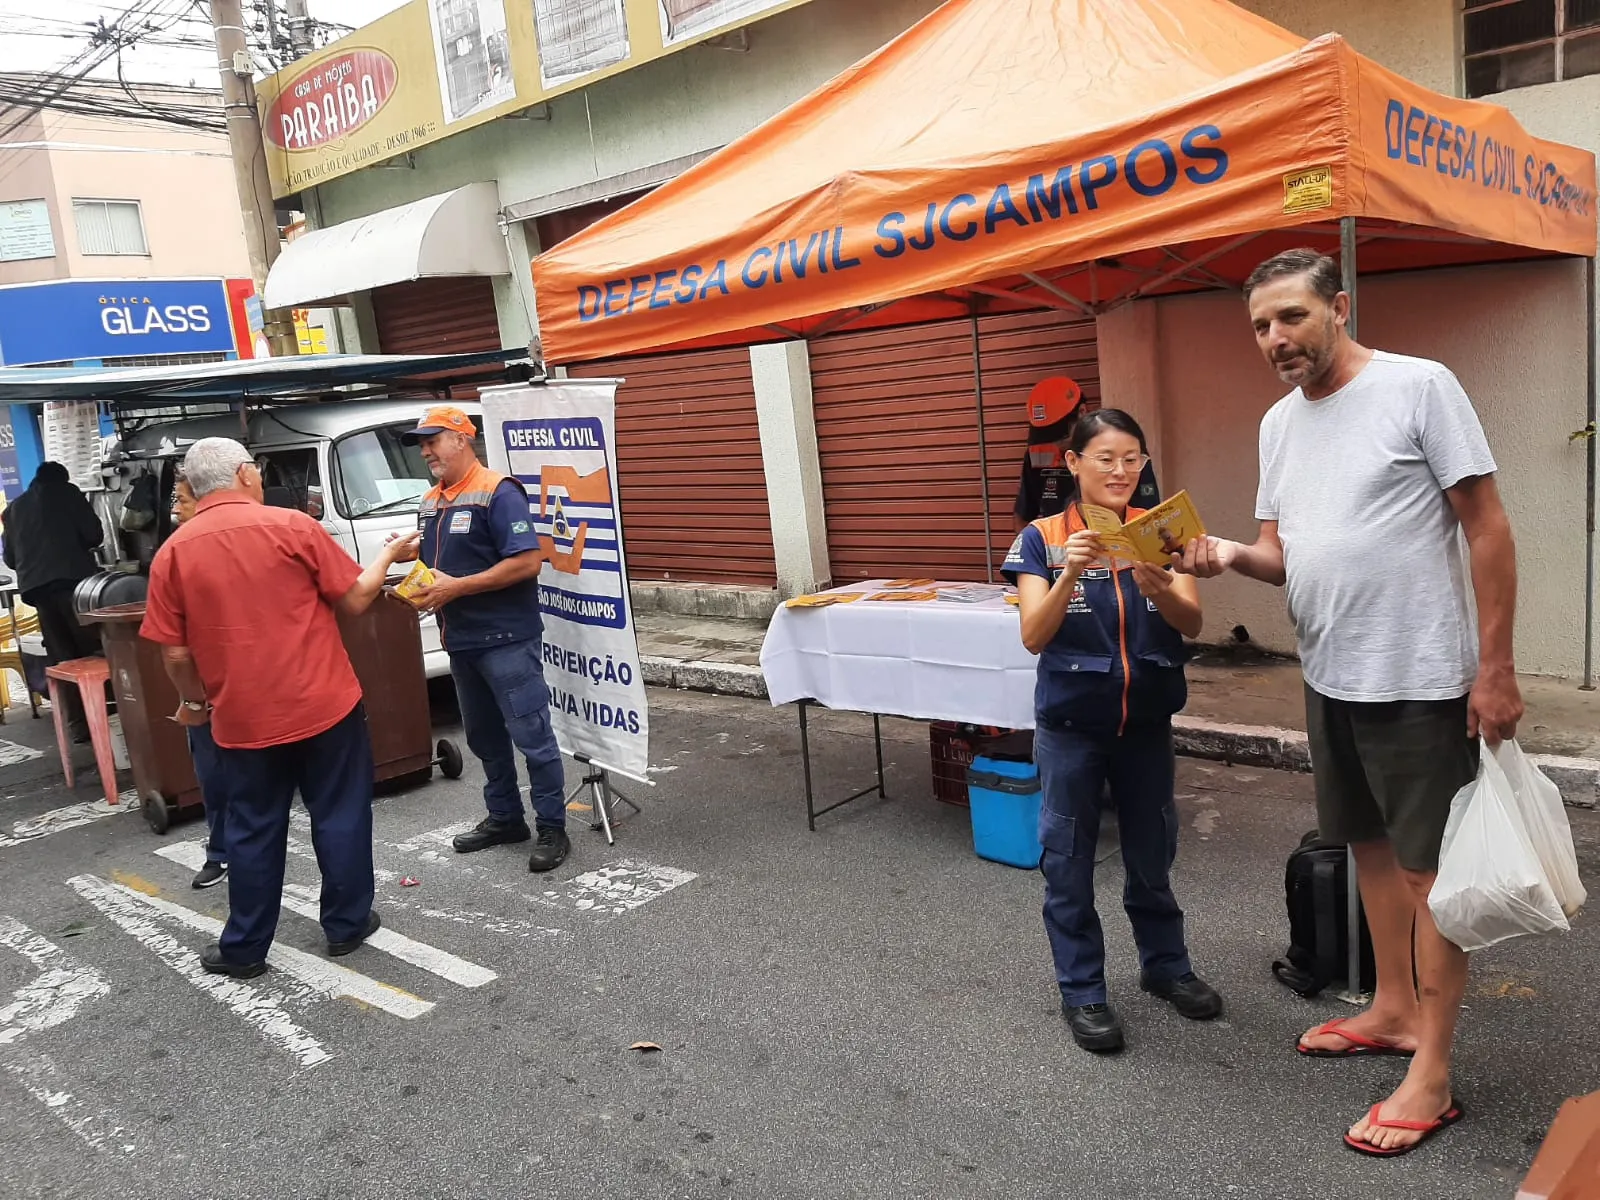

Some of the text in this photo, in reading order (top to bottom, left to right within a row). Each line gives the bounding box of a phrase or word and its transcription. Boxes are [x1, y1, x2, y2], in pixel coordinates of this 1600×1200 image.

[295, 60, 352, 98] CASA DE MÓVEIS
[281, 74, 378, 150] PARAÍBA
[342, 142, 380, 169] QUALIDADE
[387, 130, 410, 150] DESDE
[411, 128, 427, 143] 1966
[1385, 98, 1477, 183] DEFESA
[1482, 136, 1521, 195] CIVIL
[577, 124, 1229, 322] DEFESA CIVIL SJCAMPOS
[98, 294, 152, 304] ÓTICA
[101, 305, 211, 335] GLASS
[508, 427, 600, 447] DEFESA CIVIL
[563, 597, 576, 614] DOS
[576, 600, 617, 620] CAMPOS
[542, 642, 633, 686] REVENÇÃO
[582, 698, 640, 734] VIDAS
